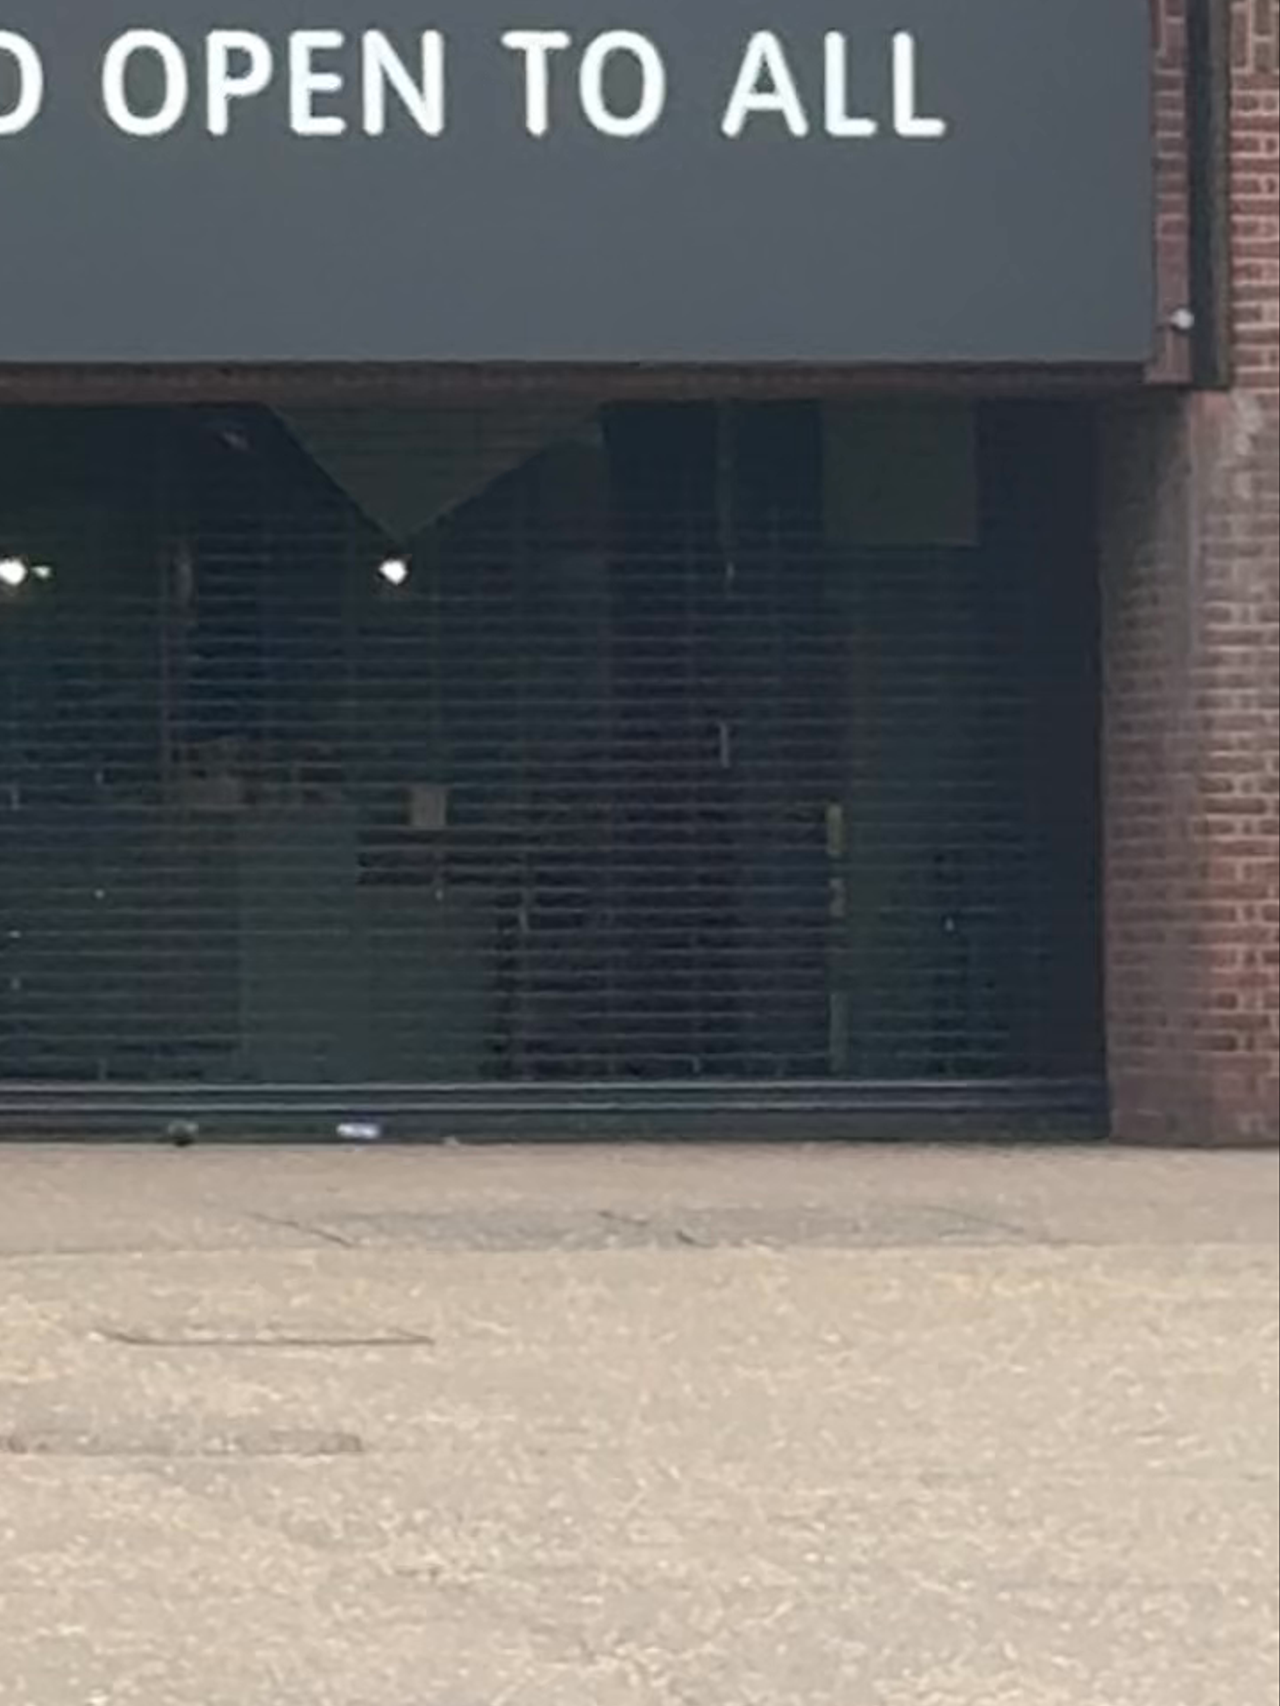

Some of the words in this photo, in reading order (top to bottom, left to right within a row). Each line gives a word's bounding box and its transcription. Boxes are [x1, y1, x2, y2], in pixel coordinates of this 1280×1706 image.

[101, 28, 445, 137] OPEN
[500, 29, 666, 138] TO
[721, 30, 946, 138] ALL
